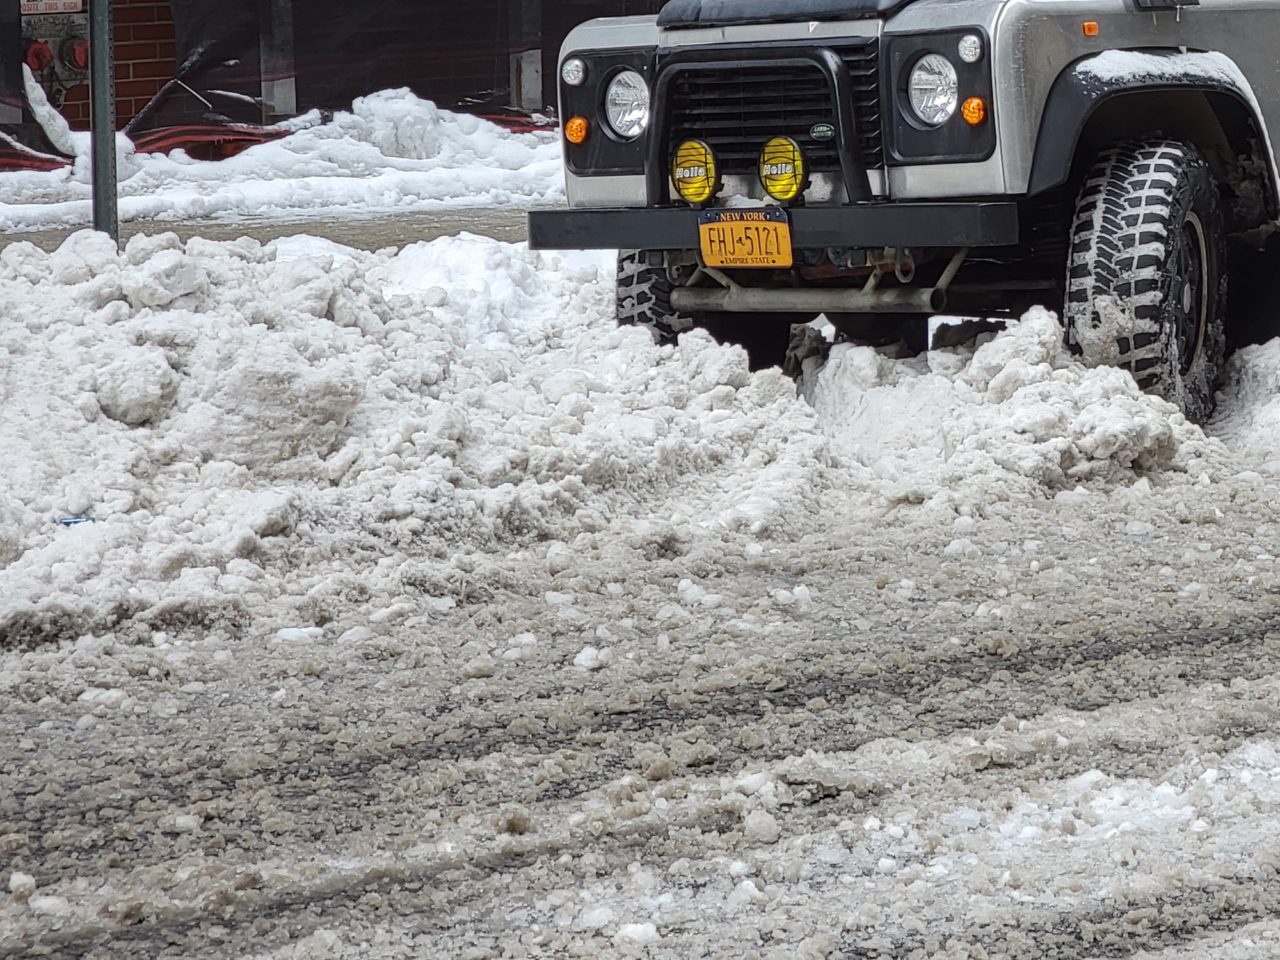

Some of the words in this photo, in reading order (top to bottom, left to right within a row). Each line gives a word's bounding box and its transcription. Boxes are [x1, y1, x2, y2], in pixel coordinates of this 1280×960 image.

[676, 166, 706, 179] Hella
[764, 163, 794, 176] Hella
[720, 212, 740, 221] NEW
[742, 212, 766, 221] YORK
[751, 256, 770, 264] STATE
